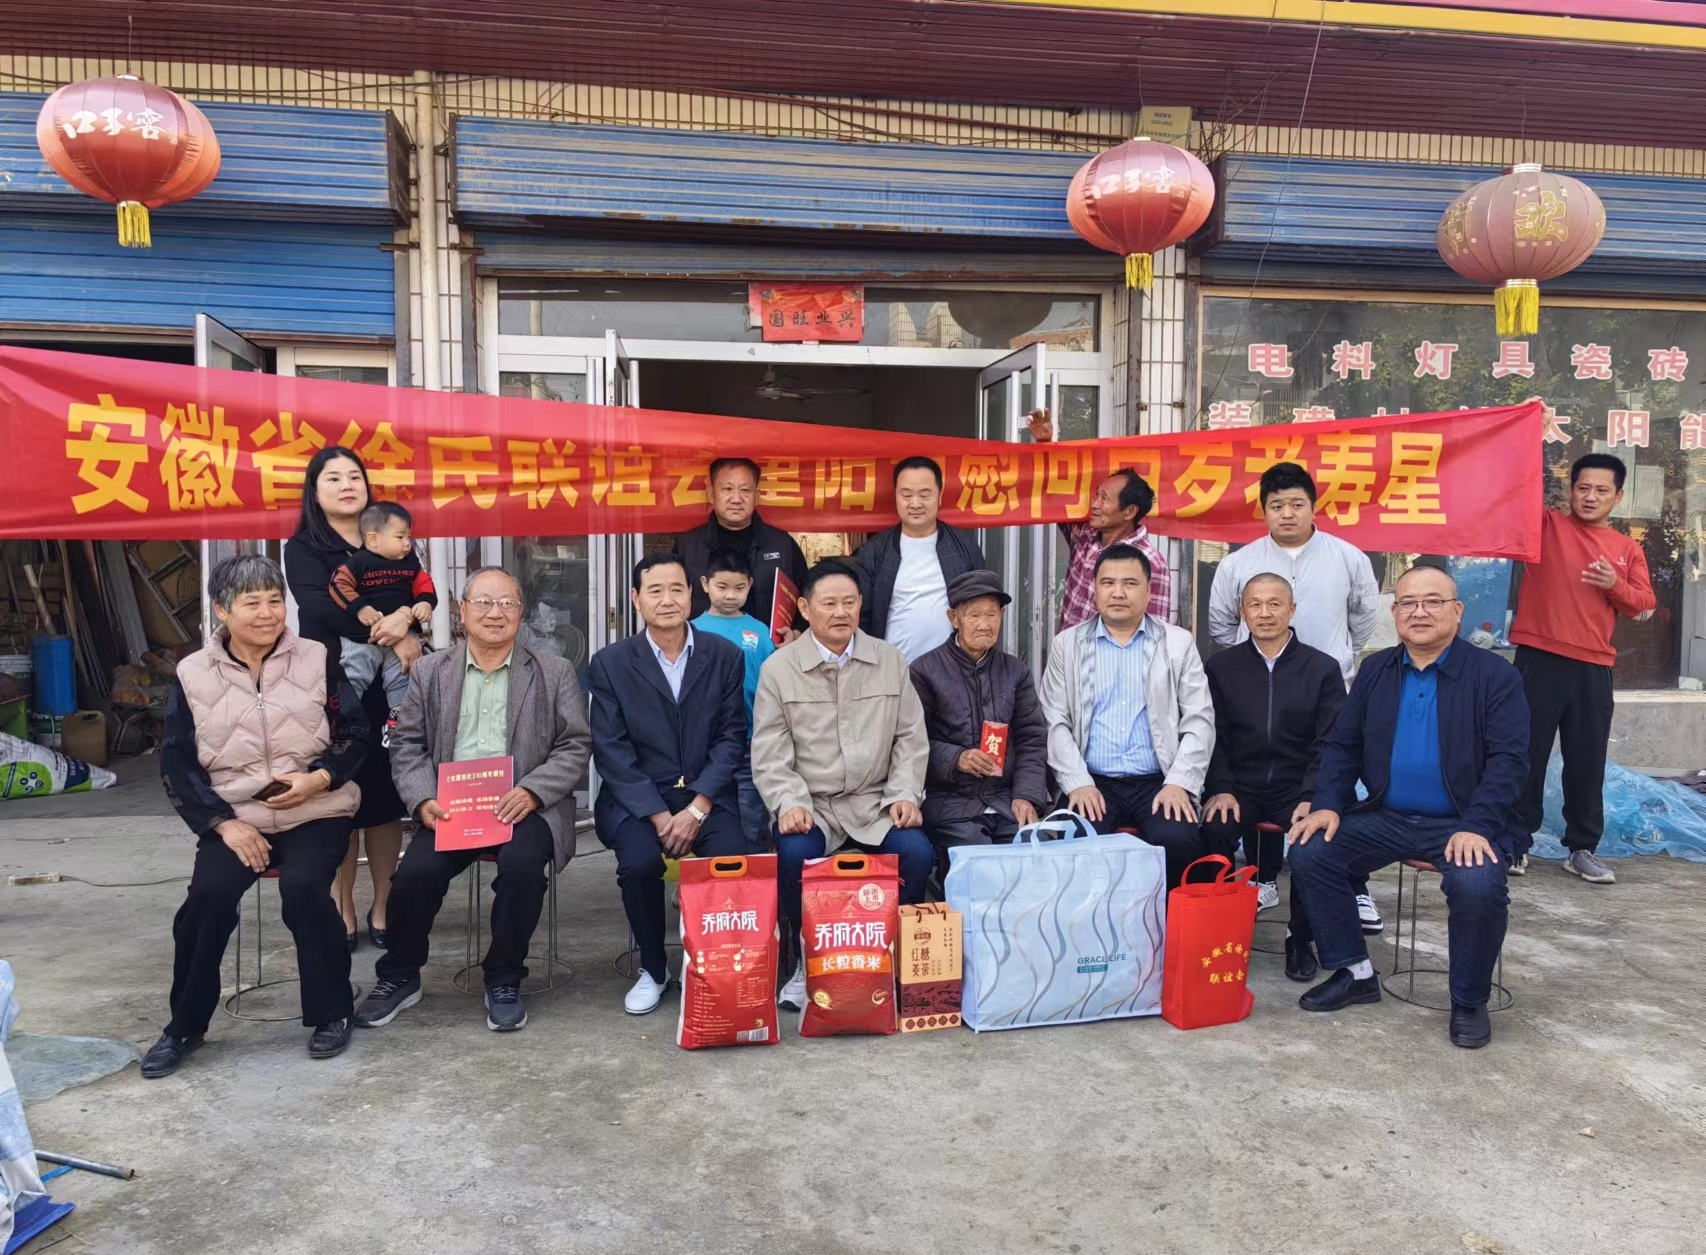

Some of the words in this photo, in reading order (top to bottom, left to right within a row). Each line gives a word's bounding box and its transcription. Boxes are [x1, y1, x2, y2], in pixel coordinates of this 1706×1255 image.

[1248, 340, 1689, 381] 电料灯具瓷砖
[65, 393, 1447, 525] 安徽省徐氏联谊阳慰问岁老寿星
[985, 732, 1003, 756] 贺
[701, 910, 759, 935] 乔府大院
[814, 922, 888, 951] 乔府大院
[822, 954, 881, 972] 长粒香米
[1077, 955, 1107, 965] GRACE
[1109, 953, 1126, 962] LIFE
